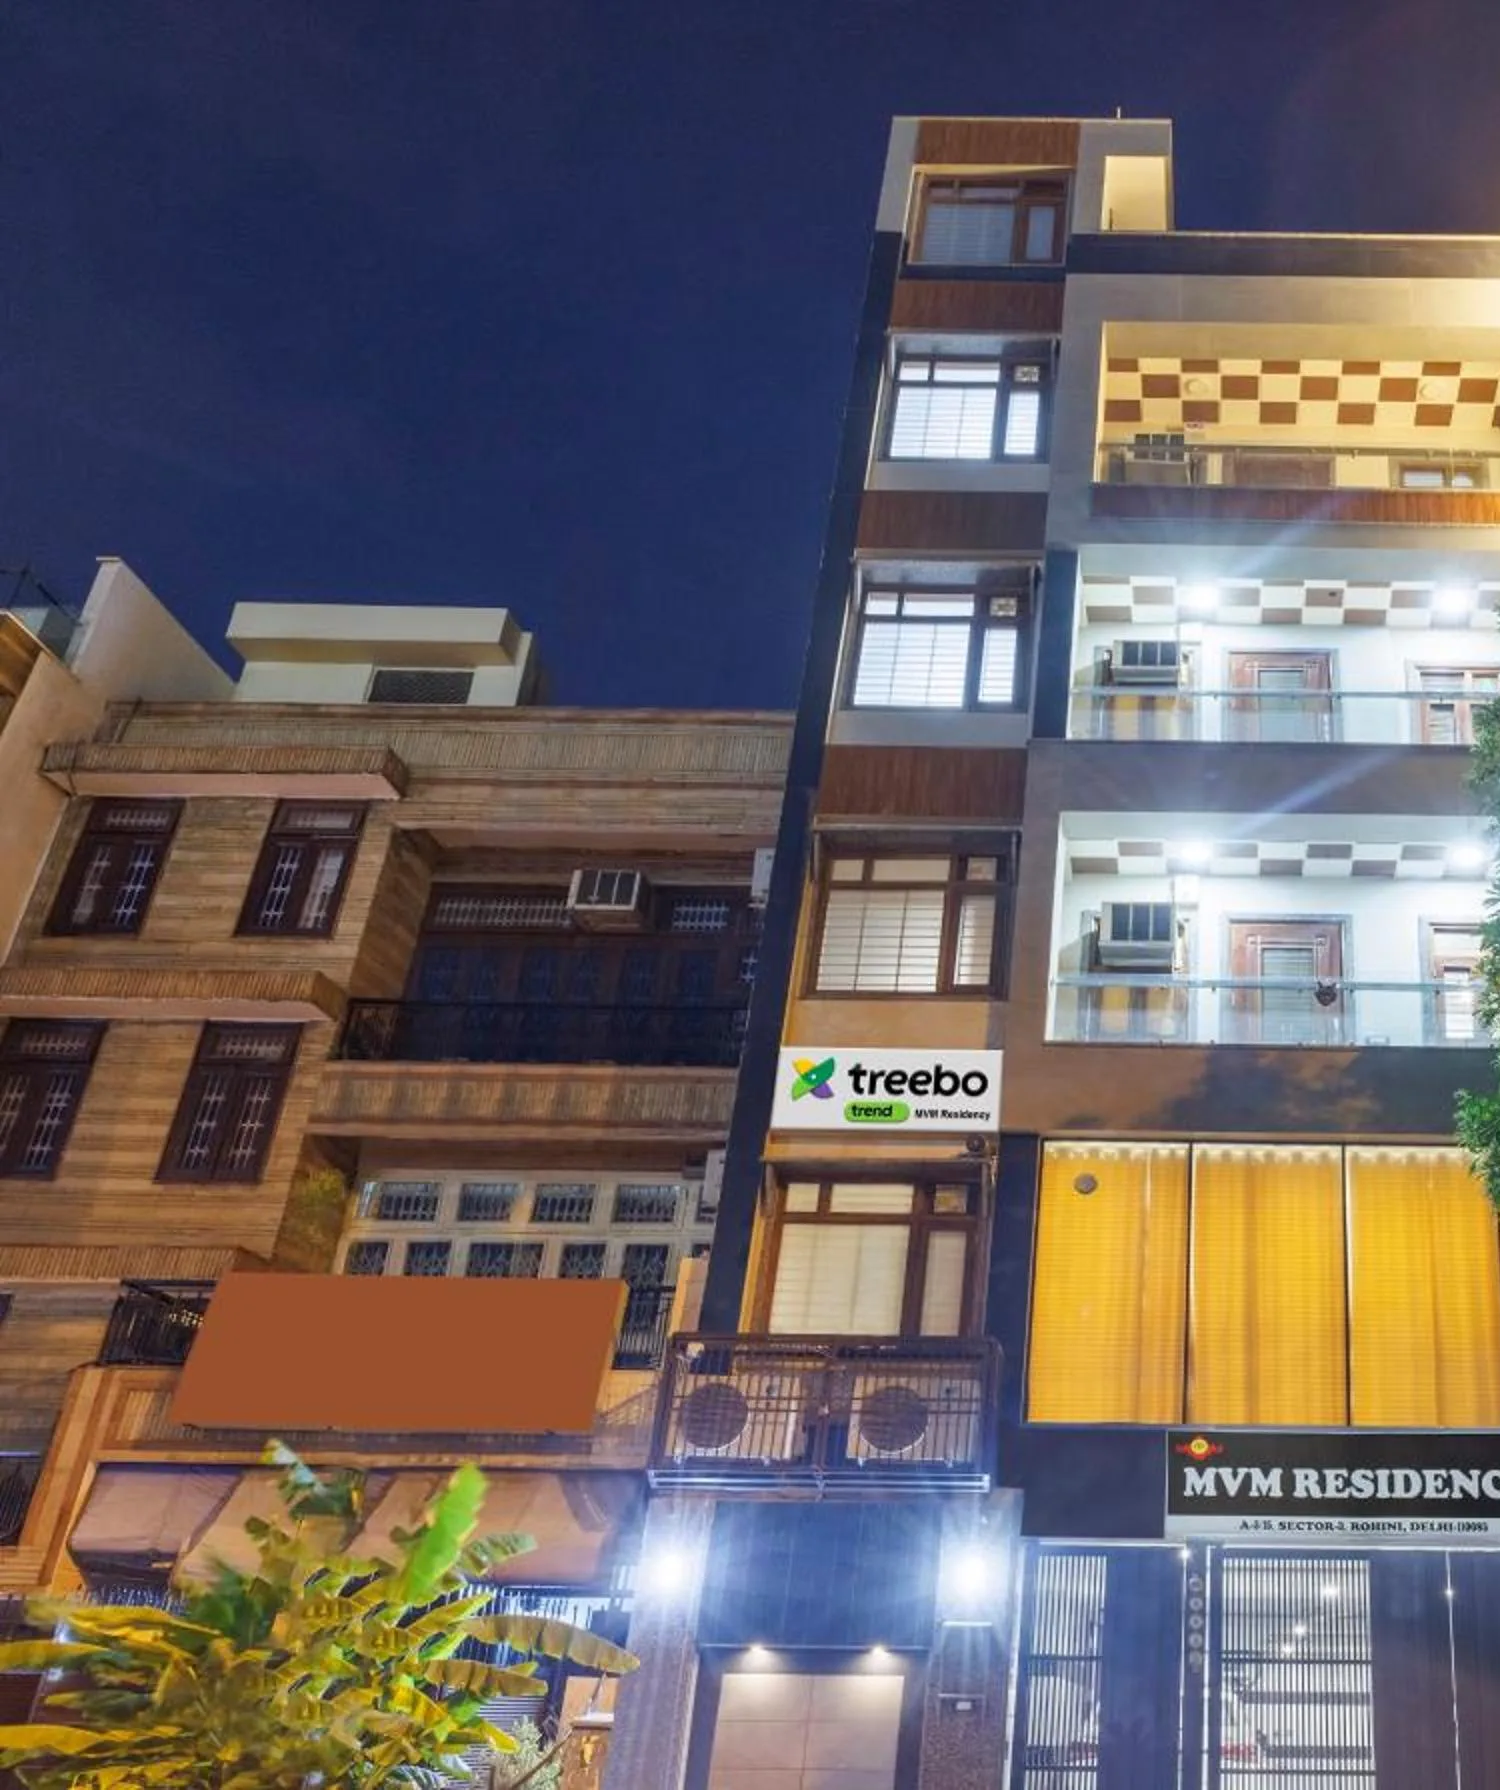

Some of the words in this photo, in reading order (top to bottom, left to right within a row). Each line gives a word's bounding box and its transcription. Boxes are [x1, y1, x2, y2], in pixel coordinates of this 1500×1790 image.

[848, 1063, 988, 1097] treebo
[851, 1104, 893, 1118] trend
[940, 1108, 991, 1121] Residency
[1183, 1466, 1283, 1498] MVM
